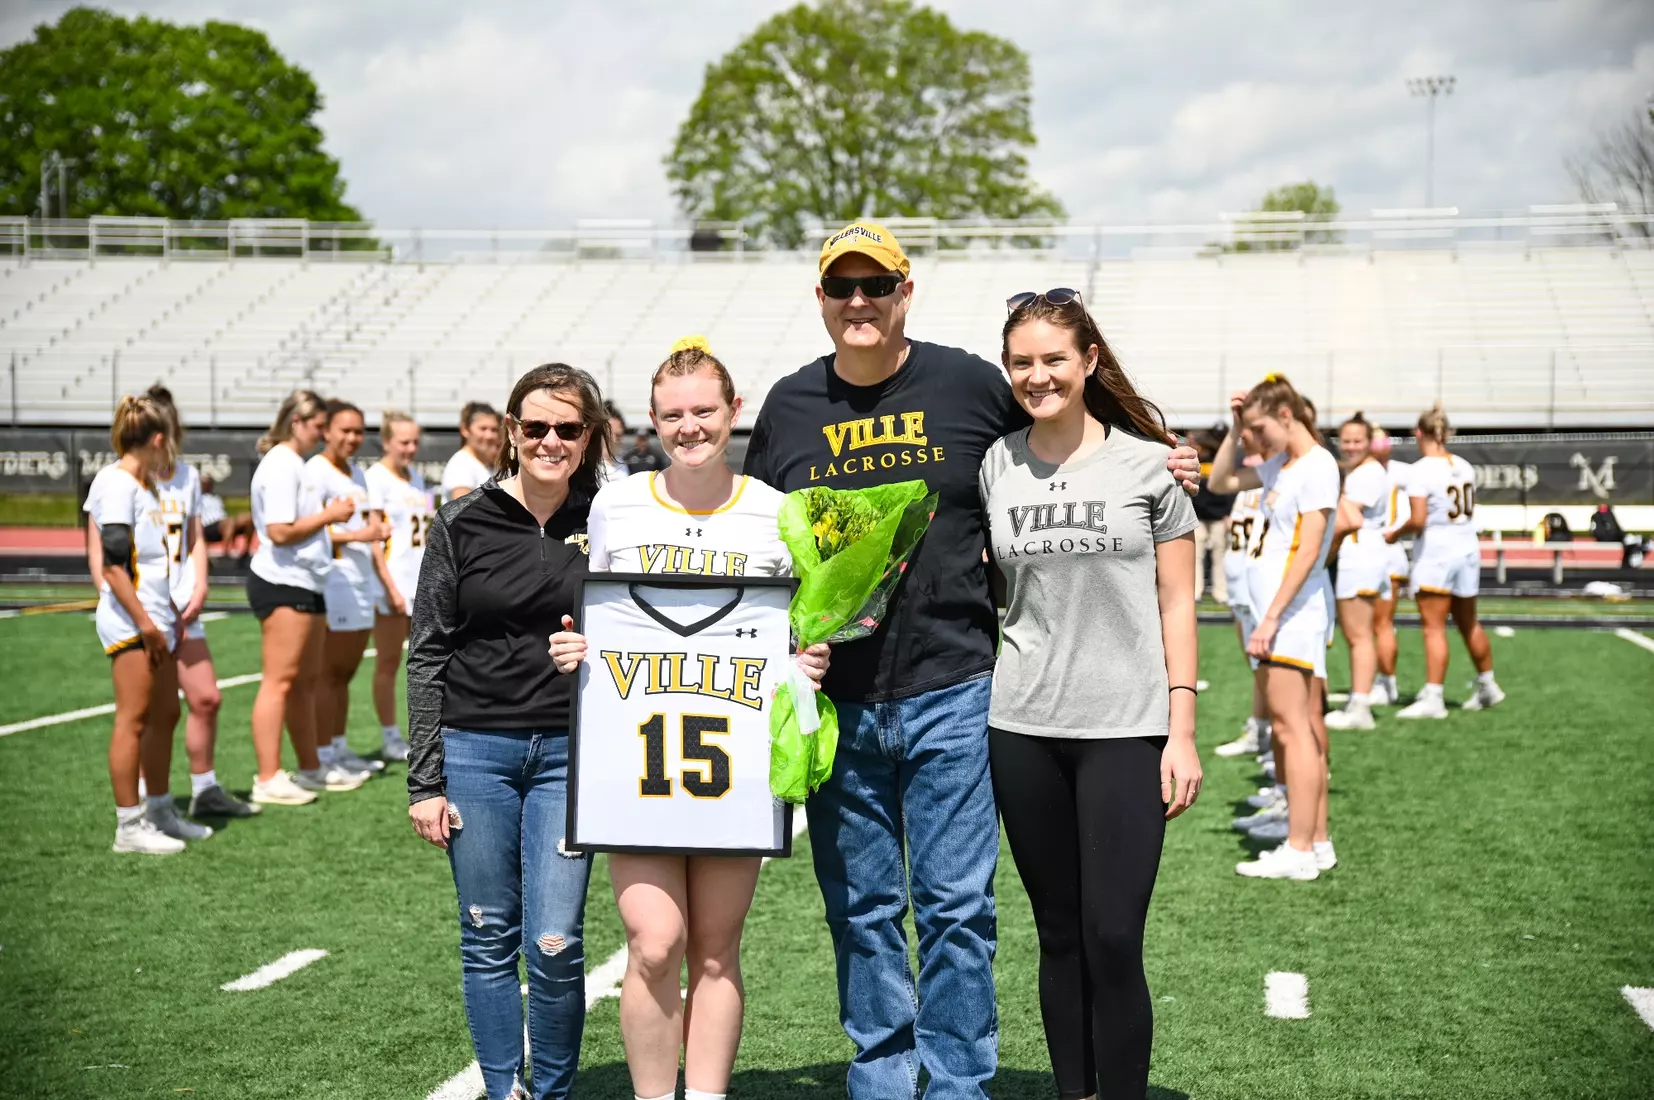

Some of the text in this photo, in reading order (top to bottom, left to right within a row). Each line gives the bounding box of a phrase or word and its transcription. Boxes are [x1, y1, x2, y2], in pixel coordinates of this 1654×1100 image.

[823, 411, 928, 457] VILLE
[0, 451, 68, 480] DERS
[809, 446, 946, 481] LACROSSE
[1007, 500, 1108, 538] VILLE
[1446, 482, 1475, 520] 30
[635, 543, 748, 577] VILLE
[996, 537, 1123, 560] LACROSSE
[600, 649, 768, 711] VILLE
[637, 711, 733, 799] 15
